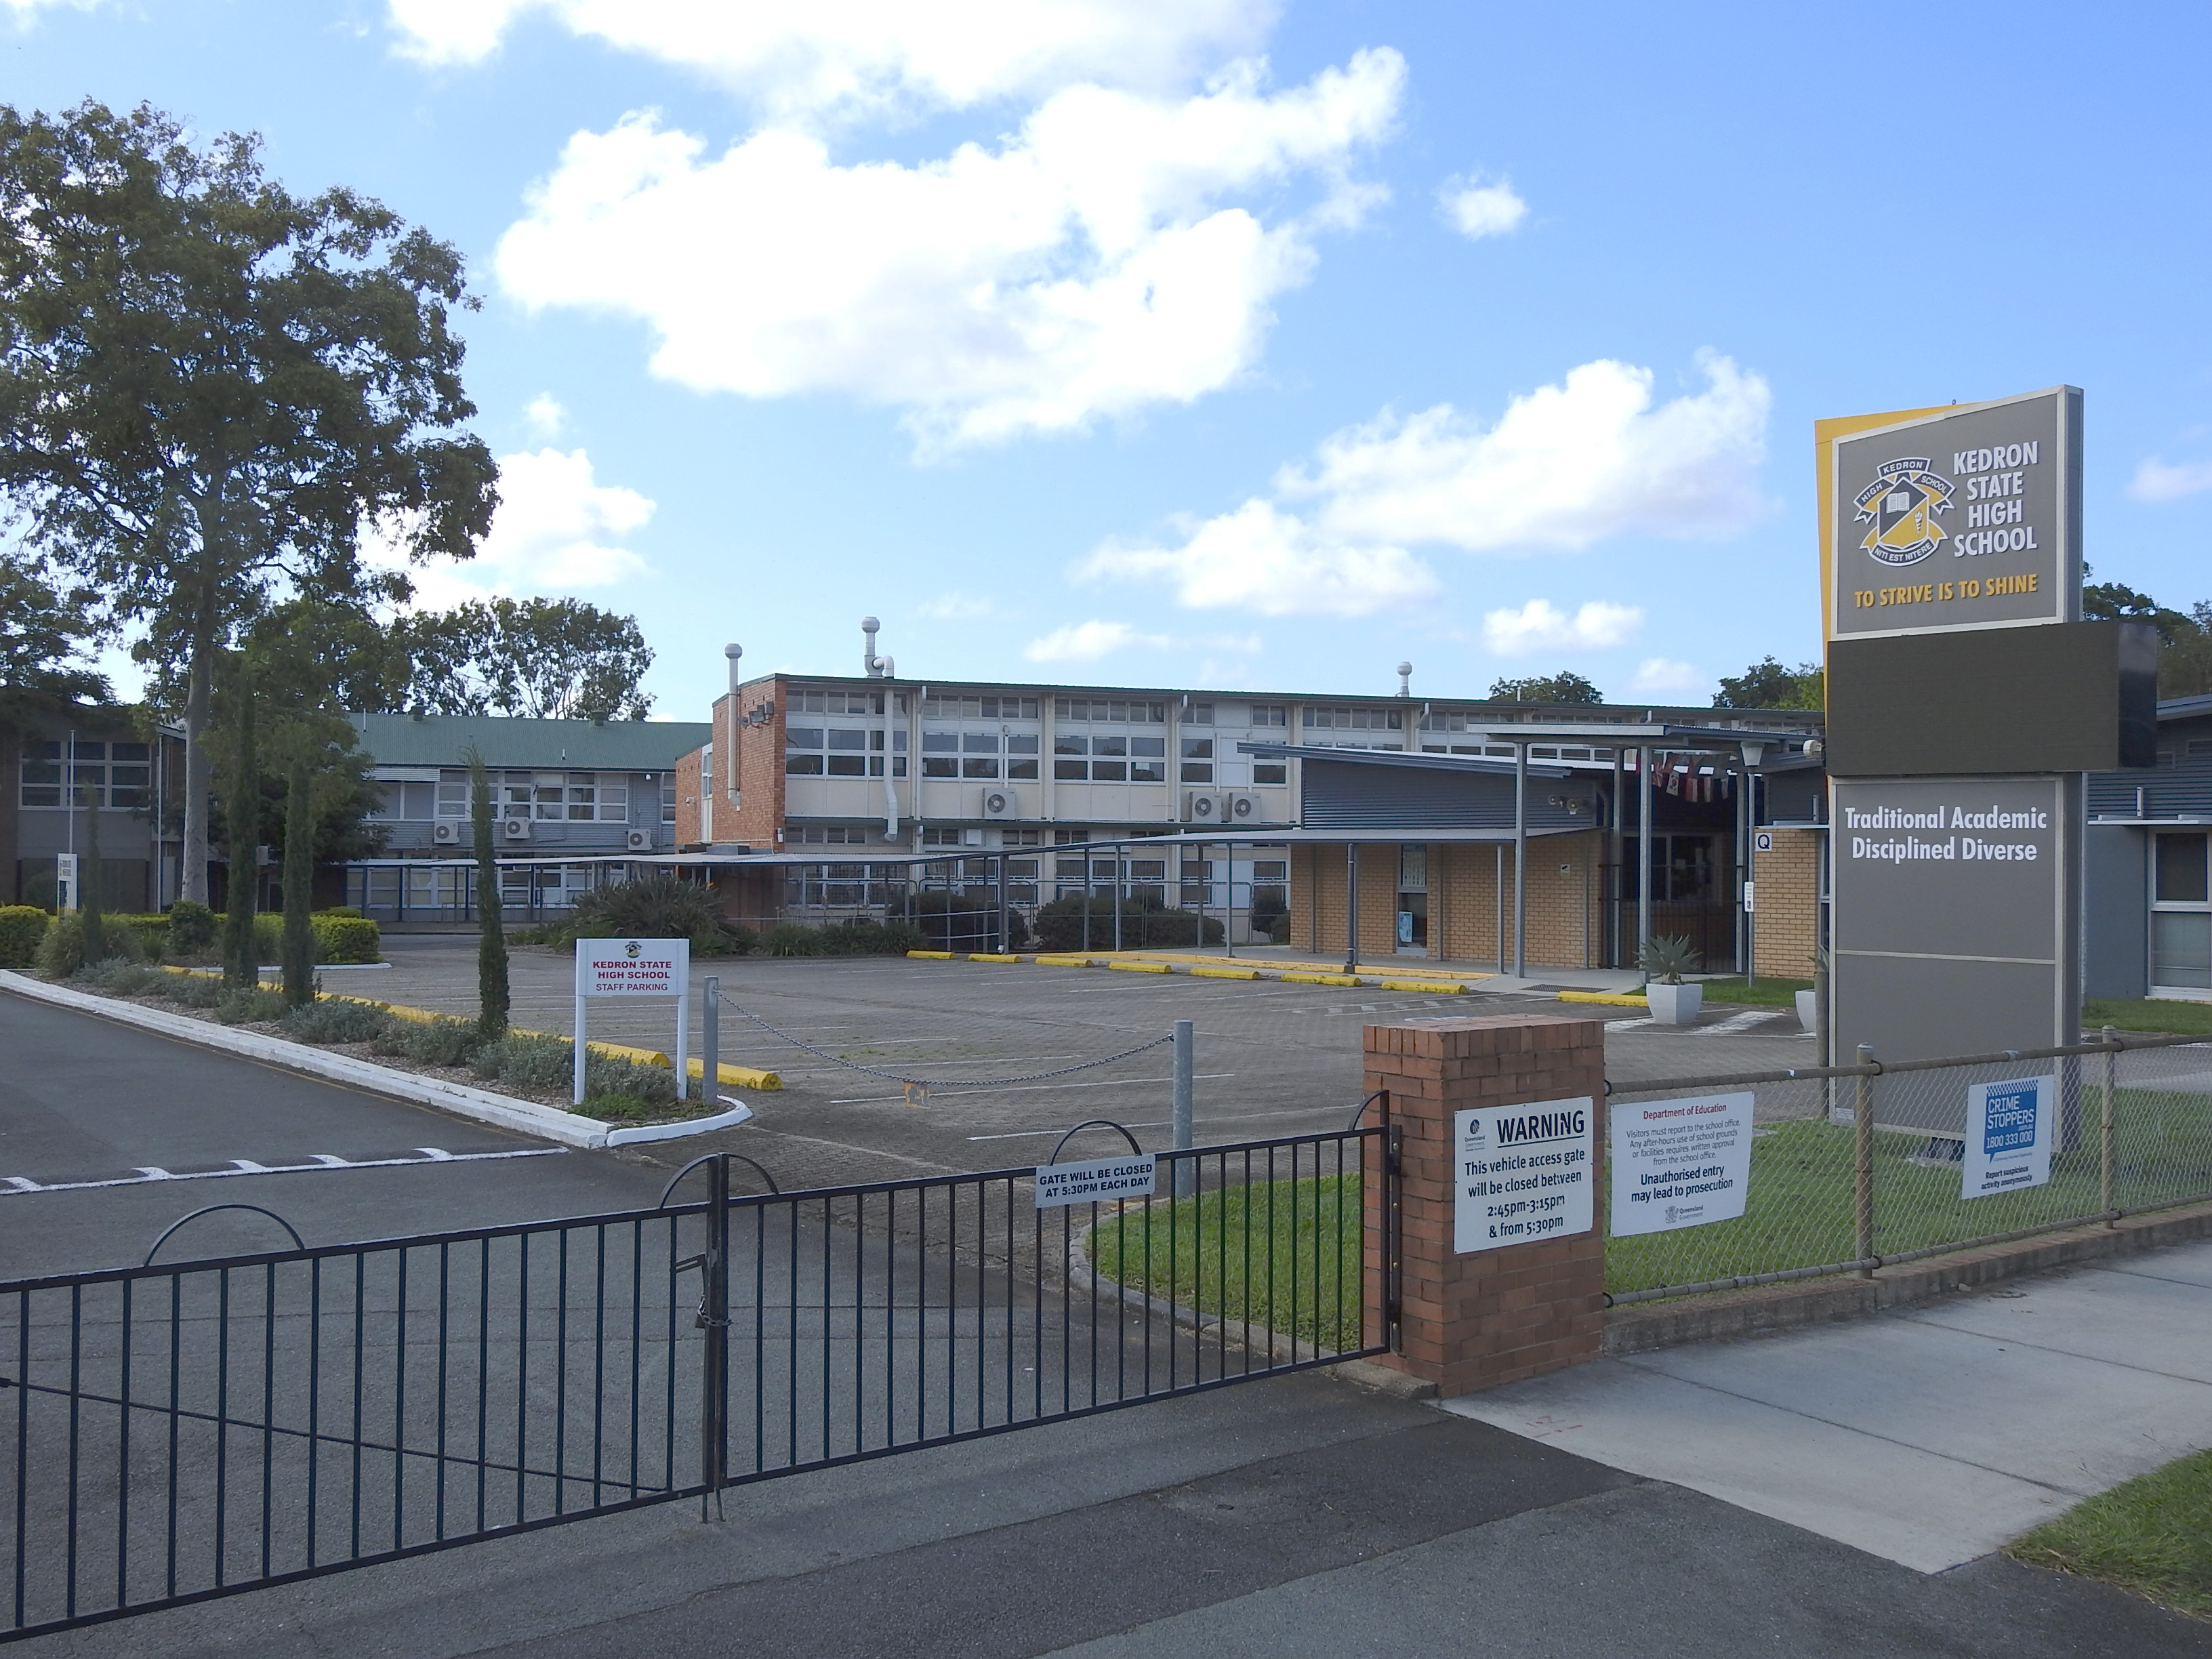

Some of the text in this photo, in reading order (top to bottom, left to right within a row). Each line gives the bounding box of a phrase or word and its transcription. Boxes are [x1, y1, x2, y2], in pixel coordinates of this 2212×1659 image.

[1883, 461, 1923, 474] KEDRON
[1954, 441, 2038, 475] KEDRON
[1861, 483, 1883, 502] HIGH
[1921, 476, 1947, 493] SCHOOL
[1967, 471, 2023, 501] STATE
[1968, 499, 2022, 529] HIGH
[1905, 542, 1932, 560] NITERE
[1954, 526, 2037, 557] SCHOOL
[1854, 574, 2037, 608] TO STRIVE IS TO SHINE
[1845, 805, 2047, 829] Traditional Academic
[1757, 834, 1770, 850] Q
[1852, 836, 2037, 865] Disciplined Diverse
[1643, 1103, 1726, 1120] Department of Education
[1988, 1095, 2020, 1114] CRIME
[1497, 1110, 1584, 1143] WARNING
[1626, 1130, 1650, 1138] Visitors
[1668, 1126, 1686, 1135] report
[1694, 1122, 1704, 1131] the
[1705, 1120, 1723, 1130] school
[1725, 1119, 1740, 1127] office.
[1987, 1108, 2034, 1130] STOPPERS
[1630, 1140, 1641, 1149] Any
[1643, 1137, 1675, 1147] after-hours
[1696, 1131, 1715, 1141] school
[1716, 1128, 1738, 1140] grounds
[1641, 1148, 1664, 1157] facilities
[1666, 1145, 1689, 1155] requires
[1691, 1143, 1710, 1151] written
[1712, 1139, 1734, 1149] approval
[1986, 1130, 2033, 1149] 1800 333 000
[1465, 1149, 1584, 1176] This vehicle access gate
[1653, 1151, 1716, 1166] from the school office.
[1040, 1164, 1152, 1185] GATE WILL BE CLOSED
[1641, 1166, 1724, 1185] Unauthorised entry
[1981, 1174, 2032, 1189] activity anonymously
[1986, 1166, 2028, 1179] Report suspicious
[1046, 1176, 1149, 1197] AT 5:30PM EACH DAY
[1469, 1172, 1582, 1197] will be closed between
[1631, 1178, 1733, 1203] may lead to prosecution
[1488, 1195, 1565, 1218] 2:45pm-3:15pm
[1679, 1205, 1703, 1214] Queensland
[1489, 1216, 1563, 1238] & from 5:30pm
